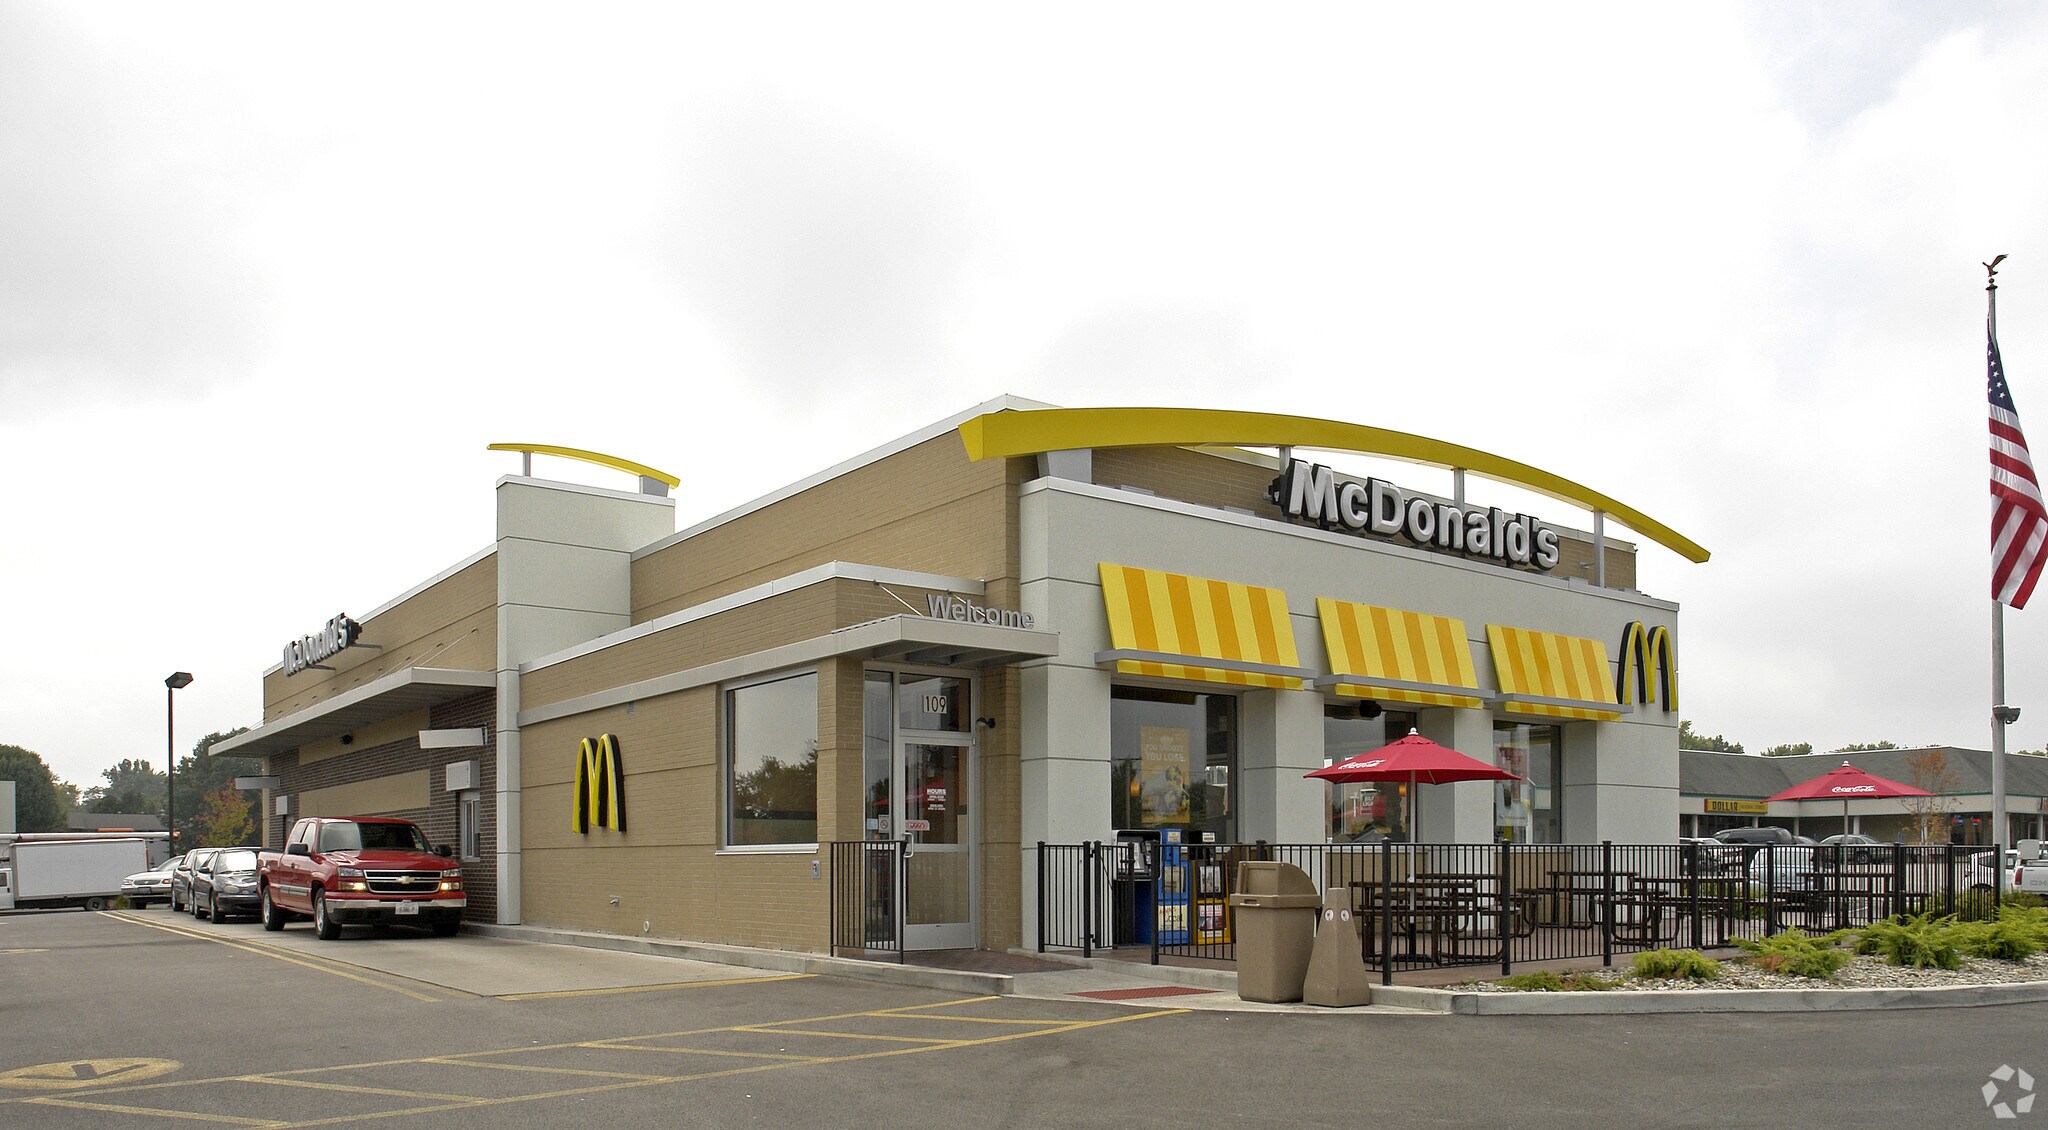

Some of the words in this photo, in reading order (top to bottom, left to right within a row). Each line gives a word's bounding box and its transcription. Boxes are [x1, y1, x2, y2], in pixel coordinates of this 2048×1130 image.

[1287, 458, 1560, 571] McDonald's
[926, 593, 1035, 629] Welcome
[925, 695, 947, 713] 109
[1145, 751, 1162, 761] YOU
[926, 788, 947, 796] HOURS
[1712, 800, 1738, 811] DOLLAR
